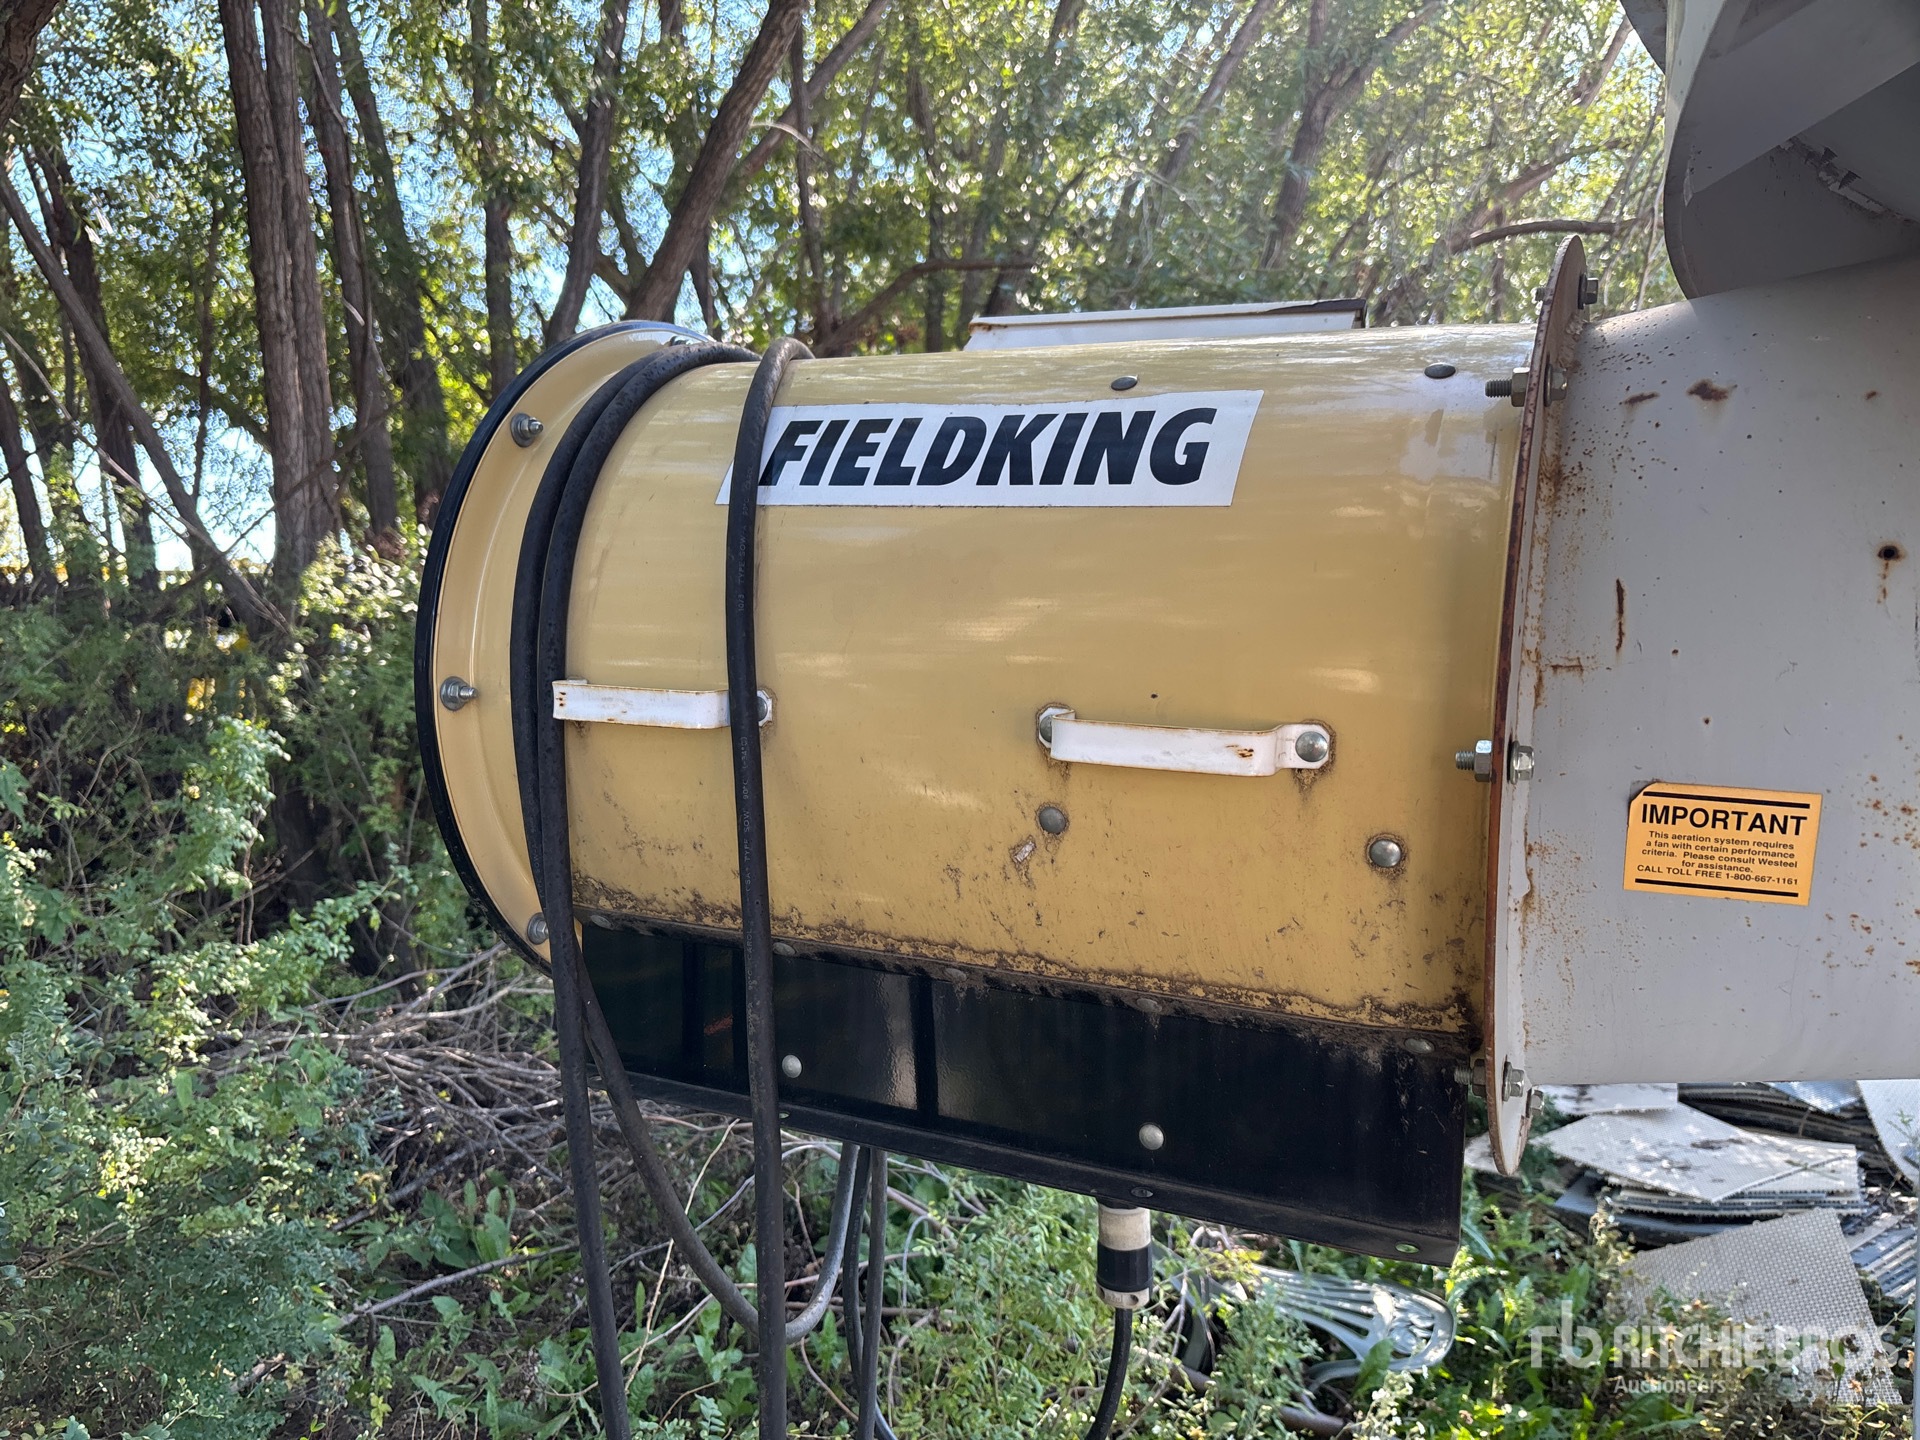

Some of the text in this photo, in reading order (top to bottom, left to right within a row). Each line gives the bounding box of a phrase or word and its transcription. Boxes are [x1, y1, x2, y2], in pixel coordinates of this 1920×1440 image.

[757, 407, 1217, 487] FIELDKING
[737, 561, 746, 585] TYPE
[742, 809, 751, 833] SOW
[1642, 803, 1807, 835] IMPORTANT
[1649, 830, 1794, 850] This aeration system requires
[1654, 840, 1669, 848] fan
[1672, 842, 1692, 850] with
[1694, 844, 1728, 853] certain
[1731, 846, 1795, 859] performance
[1642, 848, 1797, 868] criteria. Please consult Westeel
[1698, 862, 1753, 873] assistance.
[1637, 864, 1798, 885] CALL TOLL FREE 1-800-667-1161
[745, 927, 753, 961] CAROL
